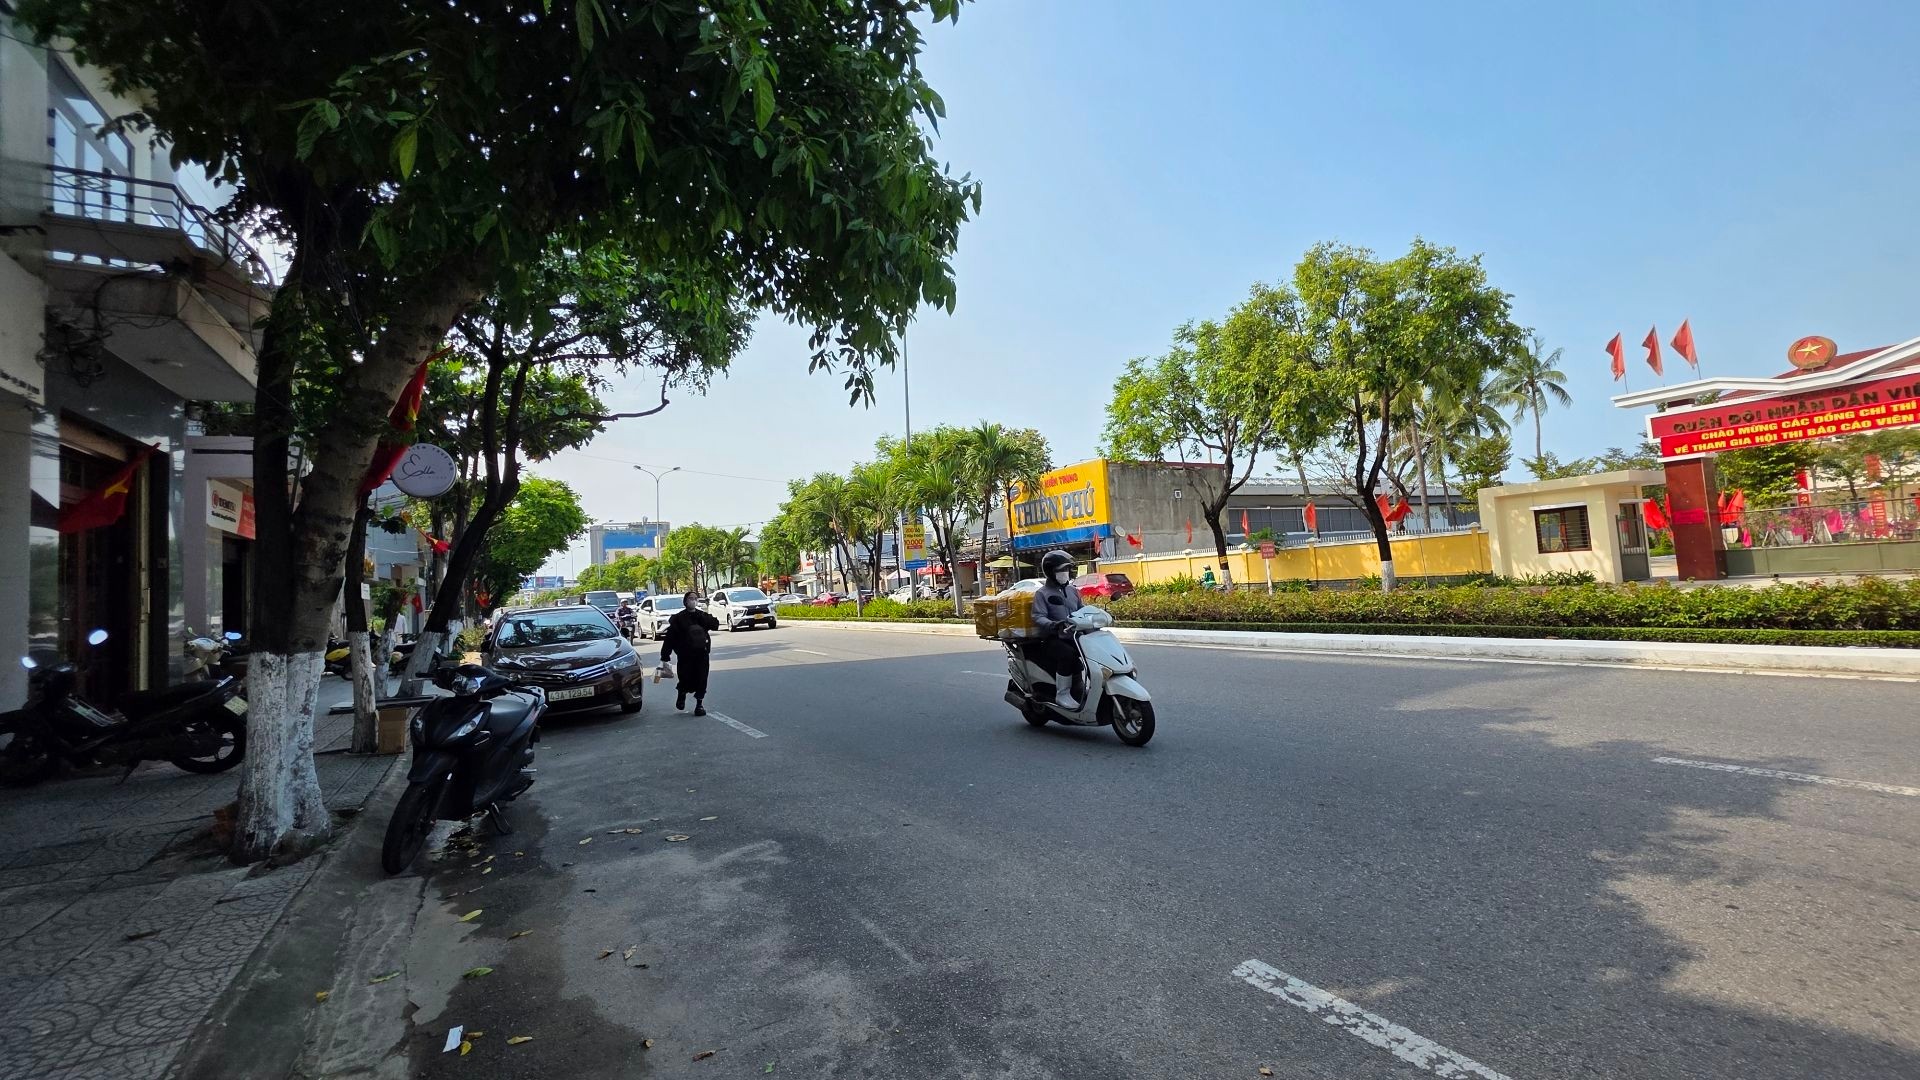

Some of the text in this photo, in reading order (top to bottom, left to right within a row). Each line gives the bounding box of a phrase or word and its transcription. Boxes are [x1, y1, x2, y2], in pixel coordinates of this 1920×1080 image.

[1674, 416, 1722, 433] QUÂN
[1768, 400, 1826, 419] NHÂN
[1832, 391, 1879, 410] DÂN
[1701, 429, 1735, 440] CHÀO
[1781, 418, 1810, 429] CÁC
[1859, 405, 1887, 417] CHÍ
[1890, 400, 1917, 412] THÍ
[1692, 440, 1726, 453] THAM
[1730, 437, 1752, 447] GIA
[1755, 432, 1778, 443] HỘI
[1781, 429, 1803, 440] THI
[1807, 424, 1837, 437] BÁO
[1840, 419, 1872, 431] CÁO
[1876, 413, 1914, 426] VIÊN
[1014, 481, 1095, 528] THIÊN PHÚ
